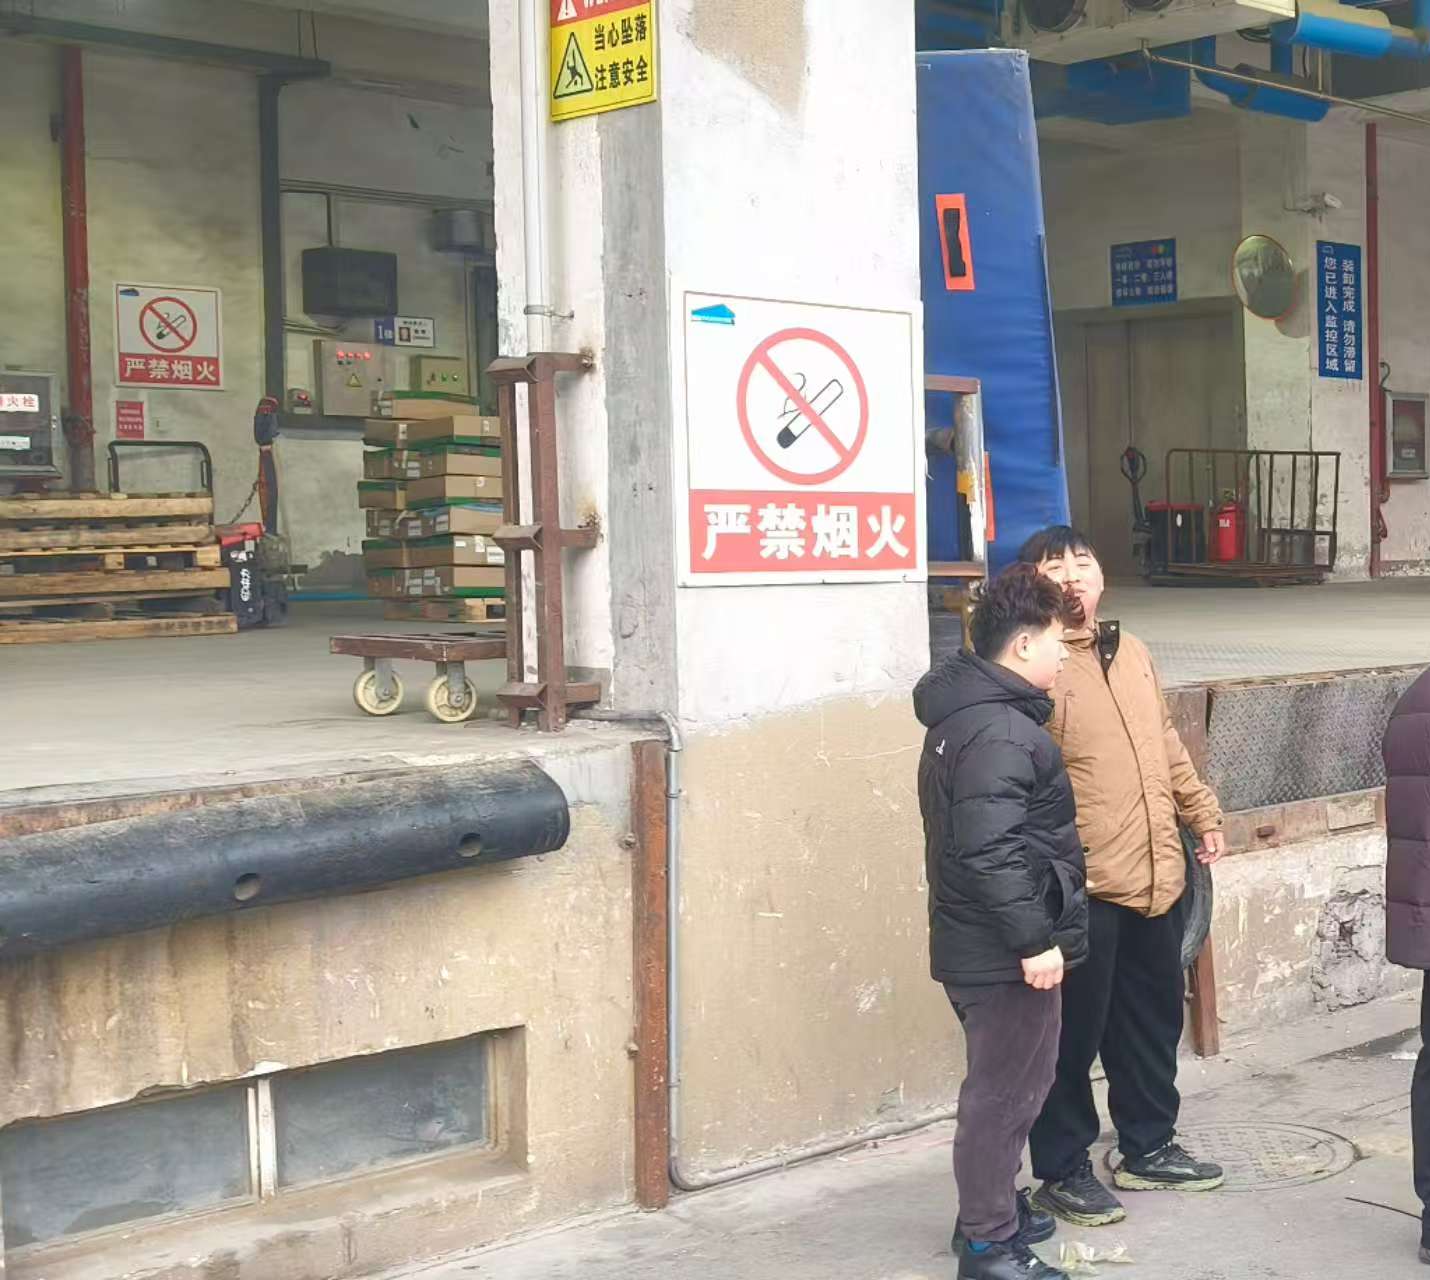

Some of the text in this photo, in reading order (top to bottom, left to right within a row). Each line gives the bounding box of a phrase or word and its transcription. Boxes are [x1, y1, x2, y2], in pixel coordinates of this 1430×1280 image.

[594, 12, 647, 50] 当心坠落
[594, 54, 648, 90] 注意安全
[1324, 257, 1339, 371] 您已进入监控区域
[1342, 259, 1356, 372] 装卸完成 请勿滞留
[124, 357, 217, 381] 严禁烟火
[0, 395, 35, 407] 火栓
[702, 503, 910, 560] 严禁烟火
